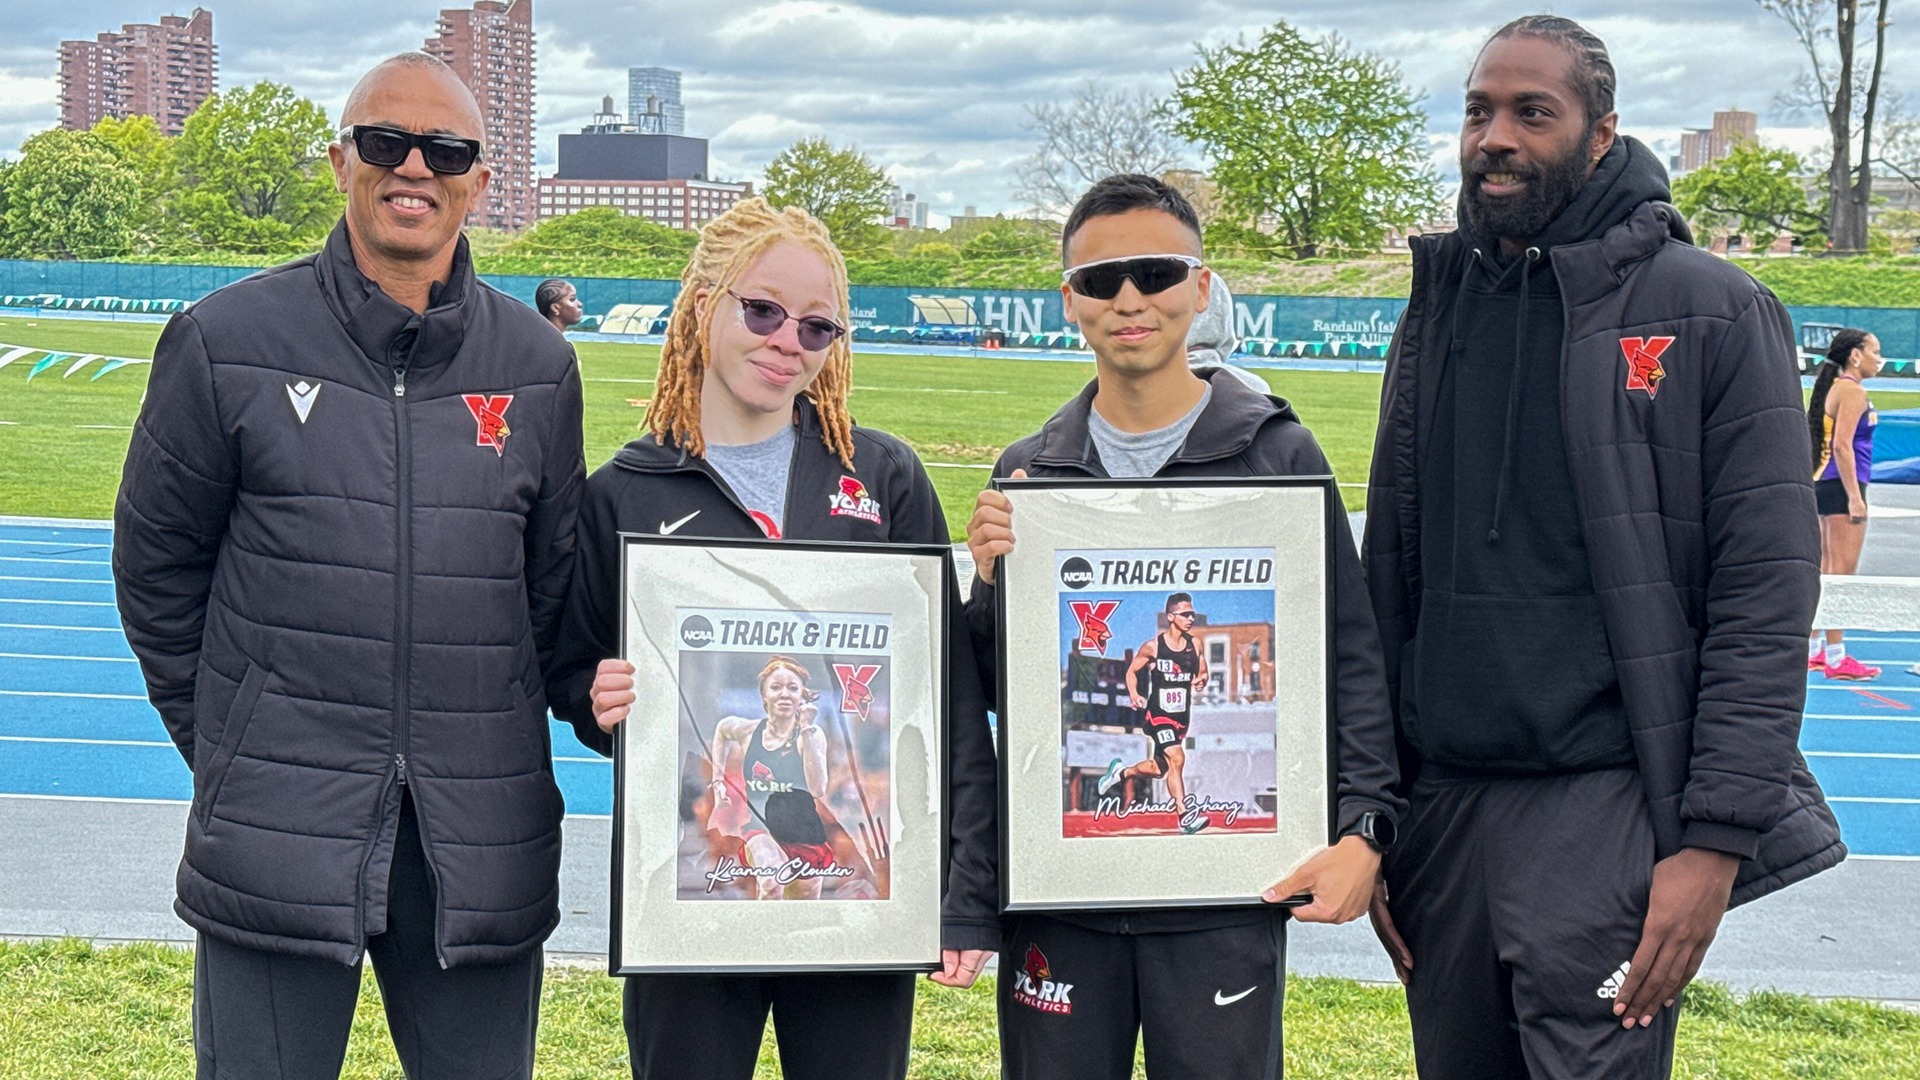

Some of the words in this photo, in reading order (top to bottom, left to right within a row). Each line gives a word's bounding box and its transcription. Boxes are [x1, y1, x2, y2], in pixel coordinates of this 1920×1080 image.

[850, 307, 877, 318] sland
[1312, 319, 1370, 332] Randall's
[1324, 332, 1355, 344] Park
[828, 493, 881, 516] YORK
[1062, 572, 1094, 582] NCAA
[1101, 560, 1180, 585] TRACK
[1184, 559, 1202, 584] &
[1207, 558, 1273, 584] FIELD
[684, 630, 713, 641] NCAA
[720, 619, 798, 647] TRACK
[802, 622, 821, 647] &
[825, 623, 890, 650] FIELD
[1159, 660, 1171, 673] 13
[1166, 691, 1182, 704] 885
[1160, 730, 1173, 742] 13
[746, 780, 794, 793] YORK
[1094, 795, 1176, 821] Michael
[1181, 793, 1243, 826] Zhang
[707, 856, 775, 893] Keanna
[776, 857, 854, 885] Clouden
[1014, 969, 1074, 1004] YORK
[1013, 992, 1070, 1013] ATHLETICS
